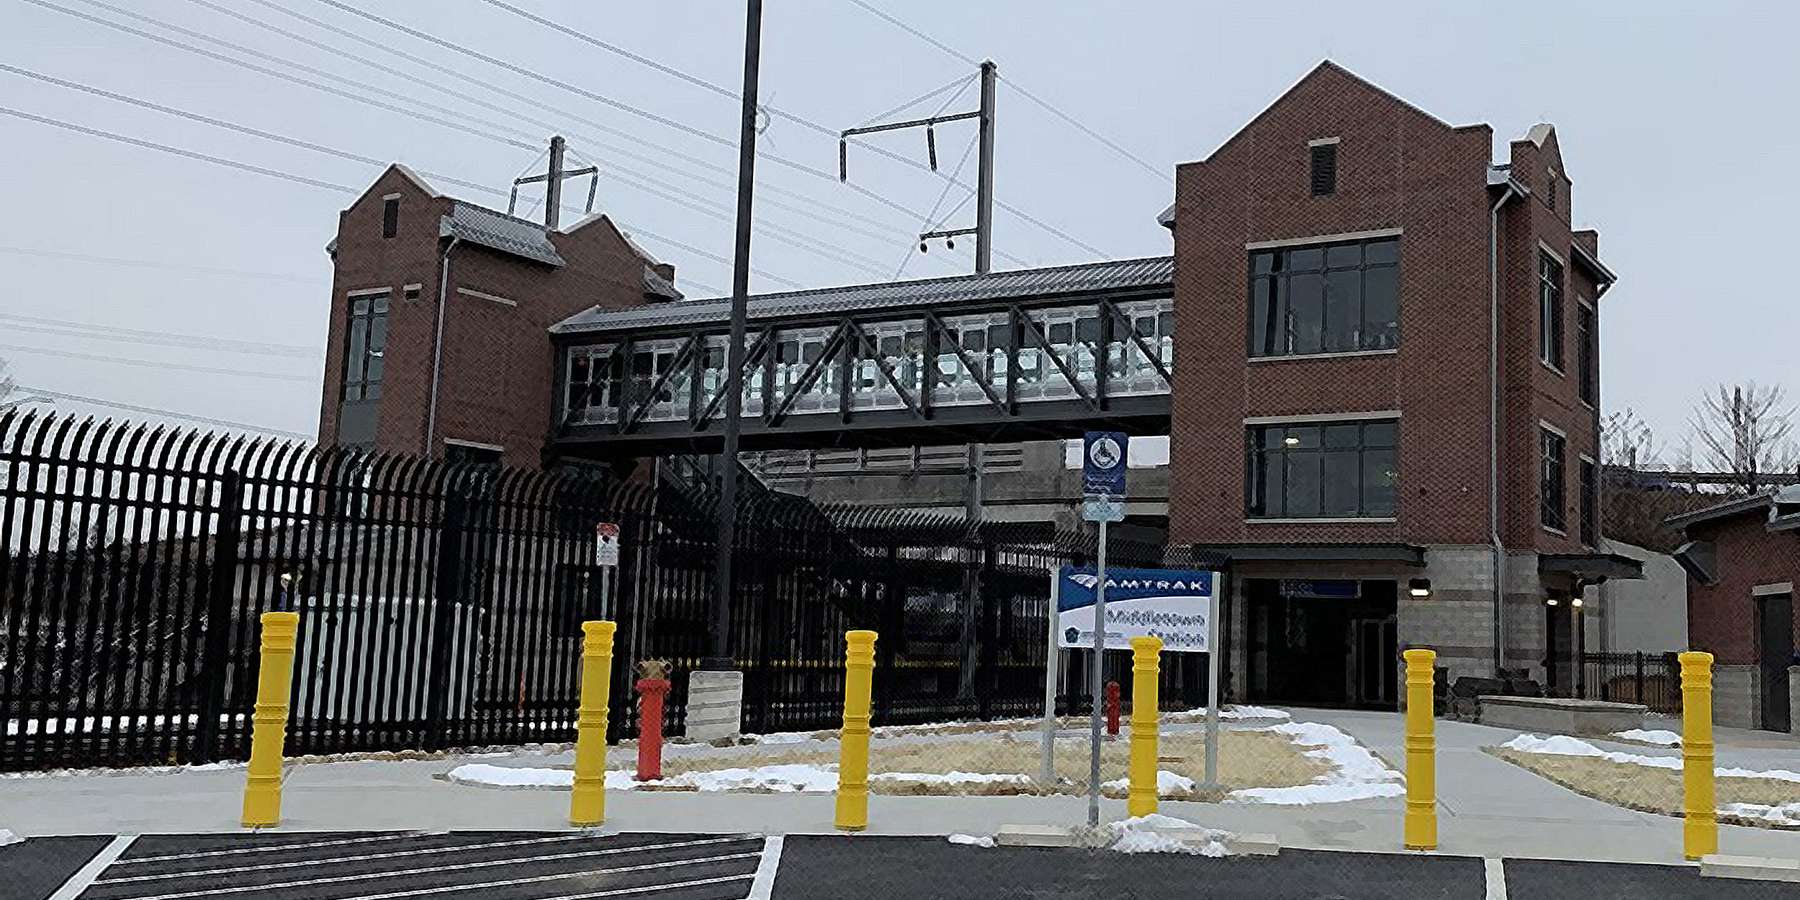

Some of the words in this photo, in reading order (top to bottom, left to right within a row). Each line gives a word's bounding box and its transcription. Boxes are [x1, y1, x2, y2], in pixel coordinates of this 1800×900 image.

[1104, 579, 1205, 590] AMTRAK
[1105, 610, 1206, 627] Middletown
[1147, 629, 1205, 647] ation
